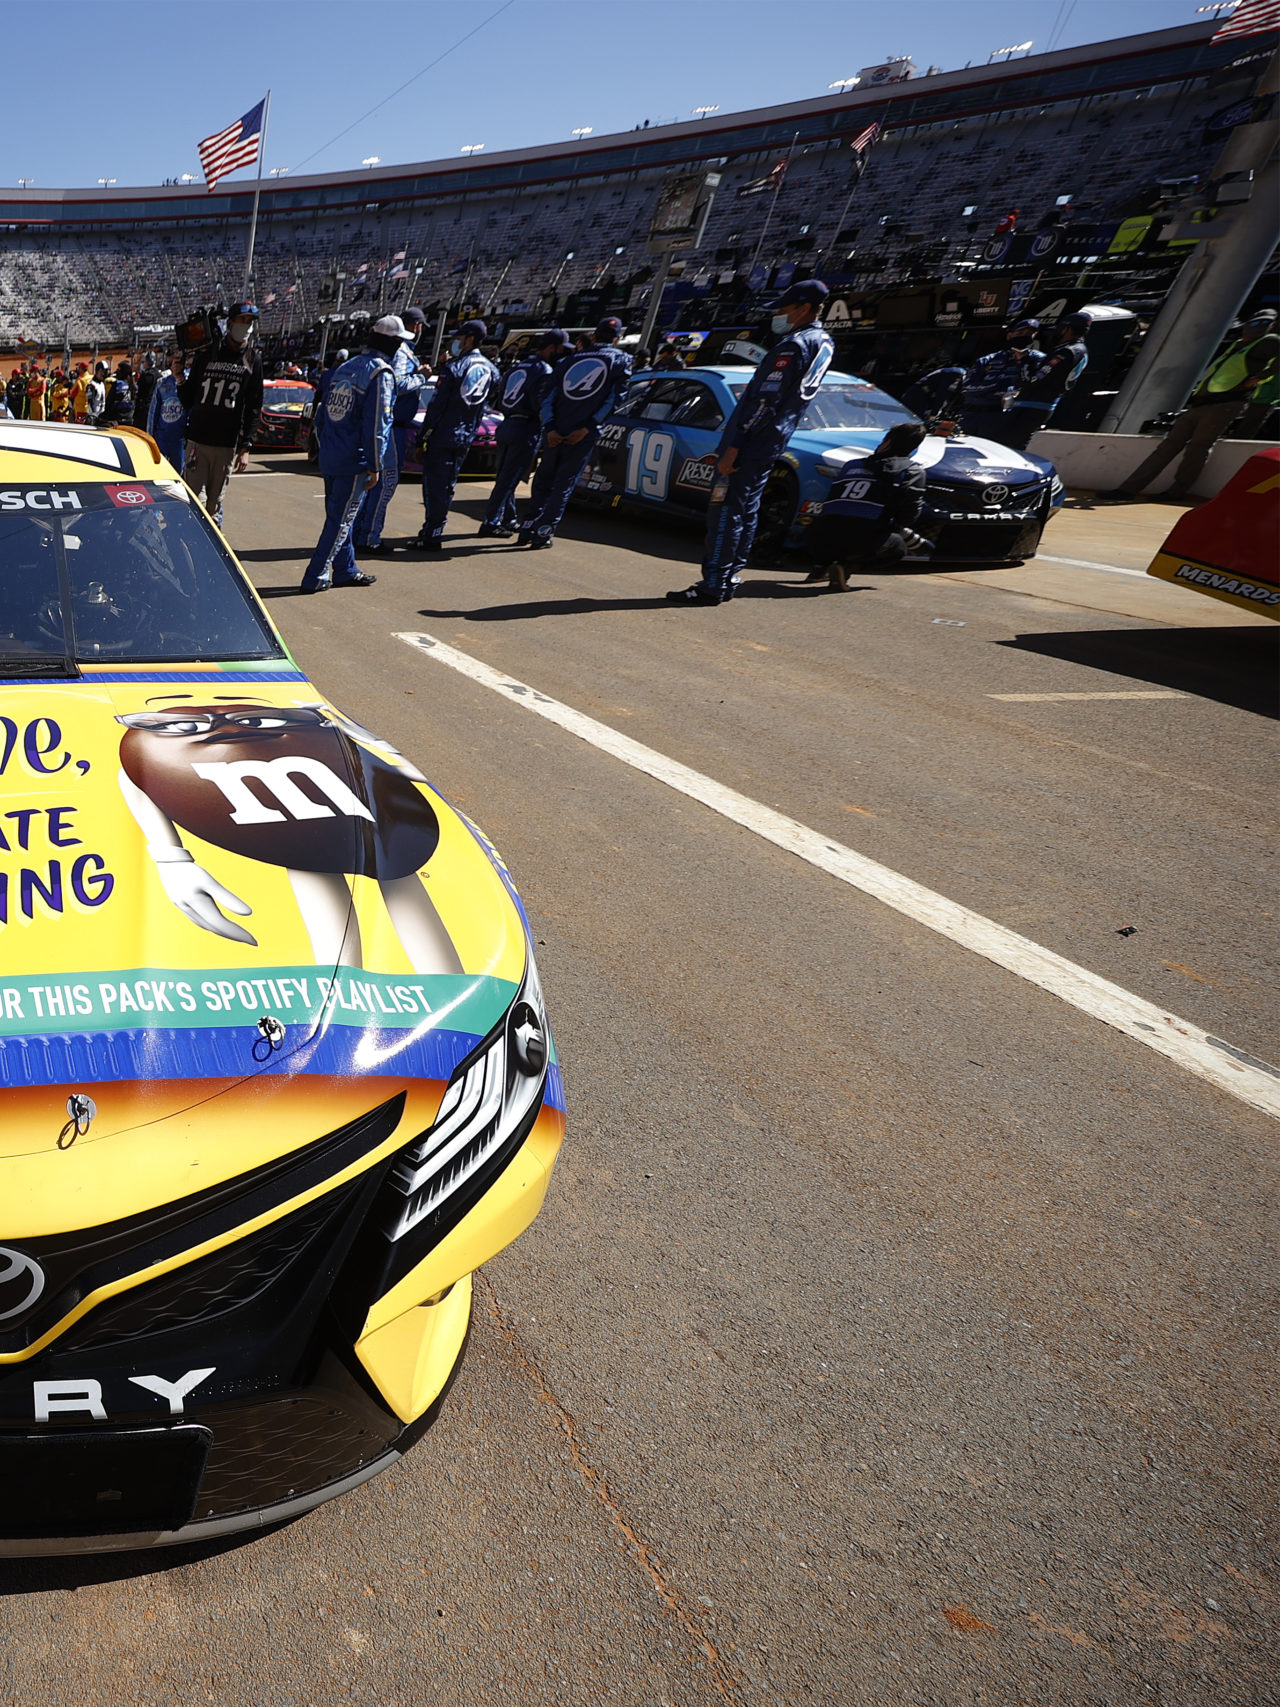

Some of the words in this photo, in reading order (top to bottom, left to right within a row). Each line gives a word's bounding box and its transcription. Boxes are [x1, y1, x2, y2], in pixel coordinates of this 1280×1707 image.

[200, 377, 241, 409] 113
[328, 391, 353, 411] BUSCH
[625, 427, 677, 501] 19
[840, 480, 871, 499] 19
[949, 512, 1027, 520] CAMRY
[1177, 565, 1280, 606] MENARDS
[28, 985, 94, 1018] THIS
[99, 980, 198, 1016] PACK'S
[201, 977, 312, 1013] SPOTIFY
[320, 978, 433, 1017] PLAYLIST
